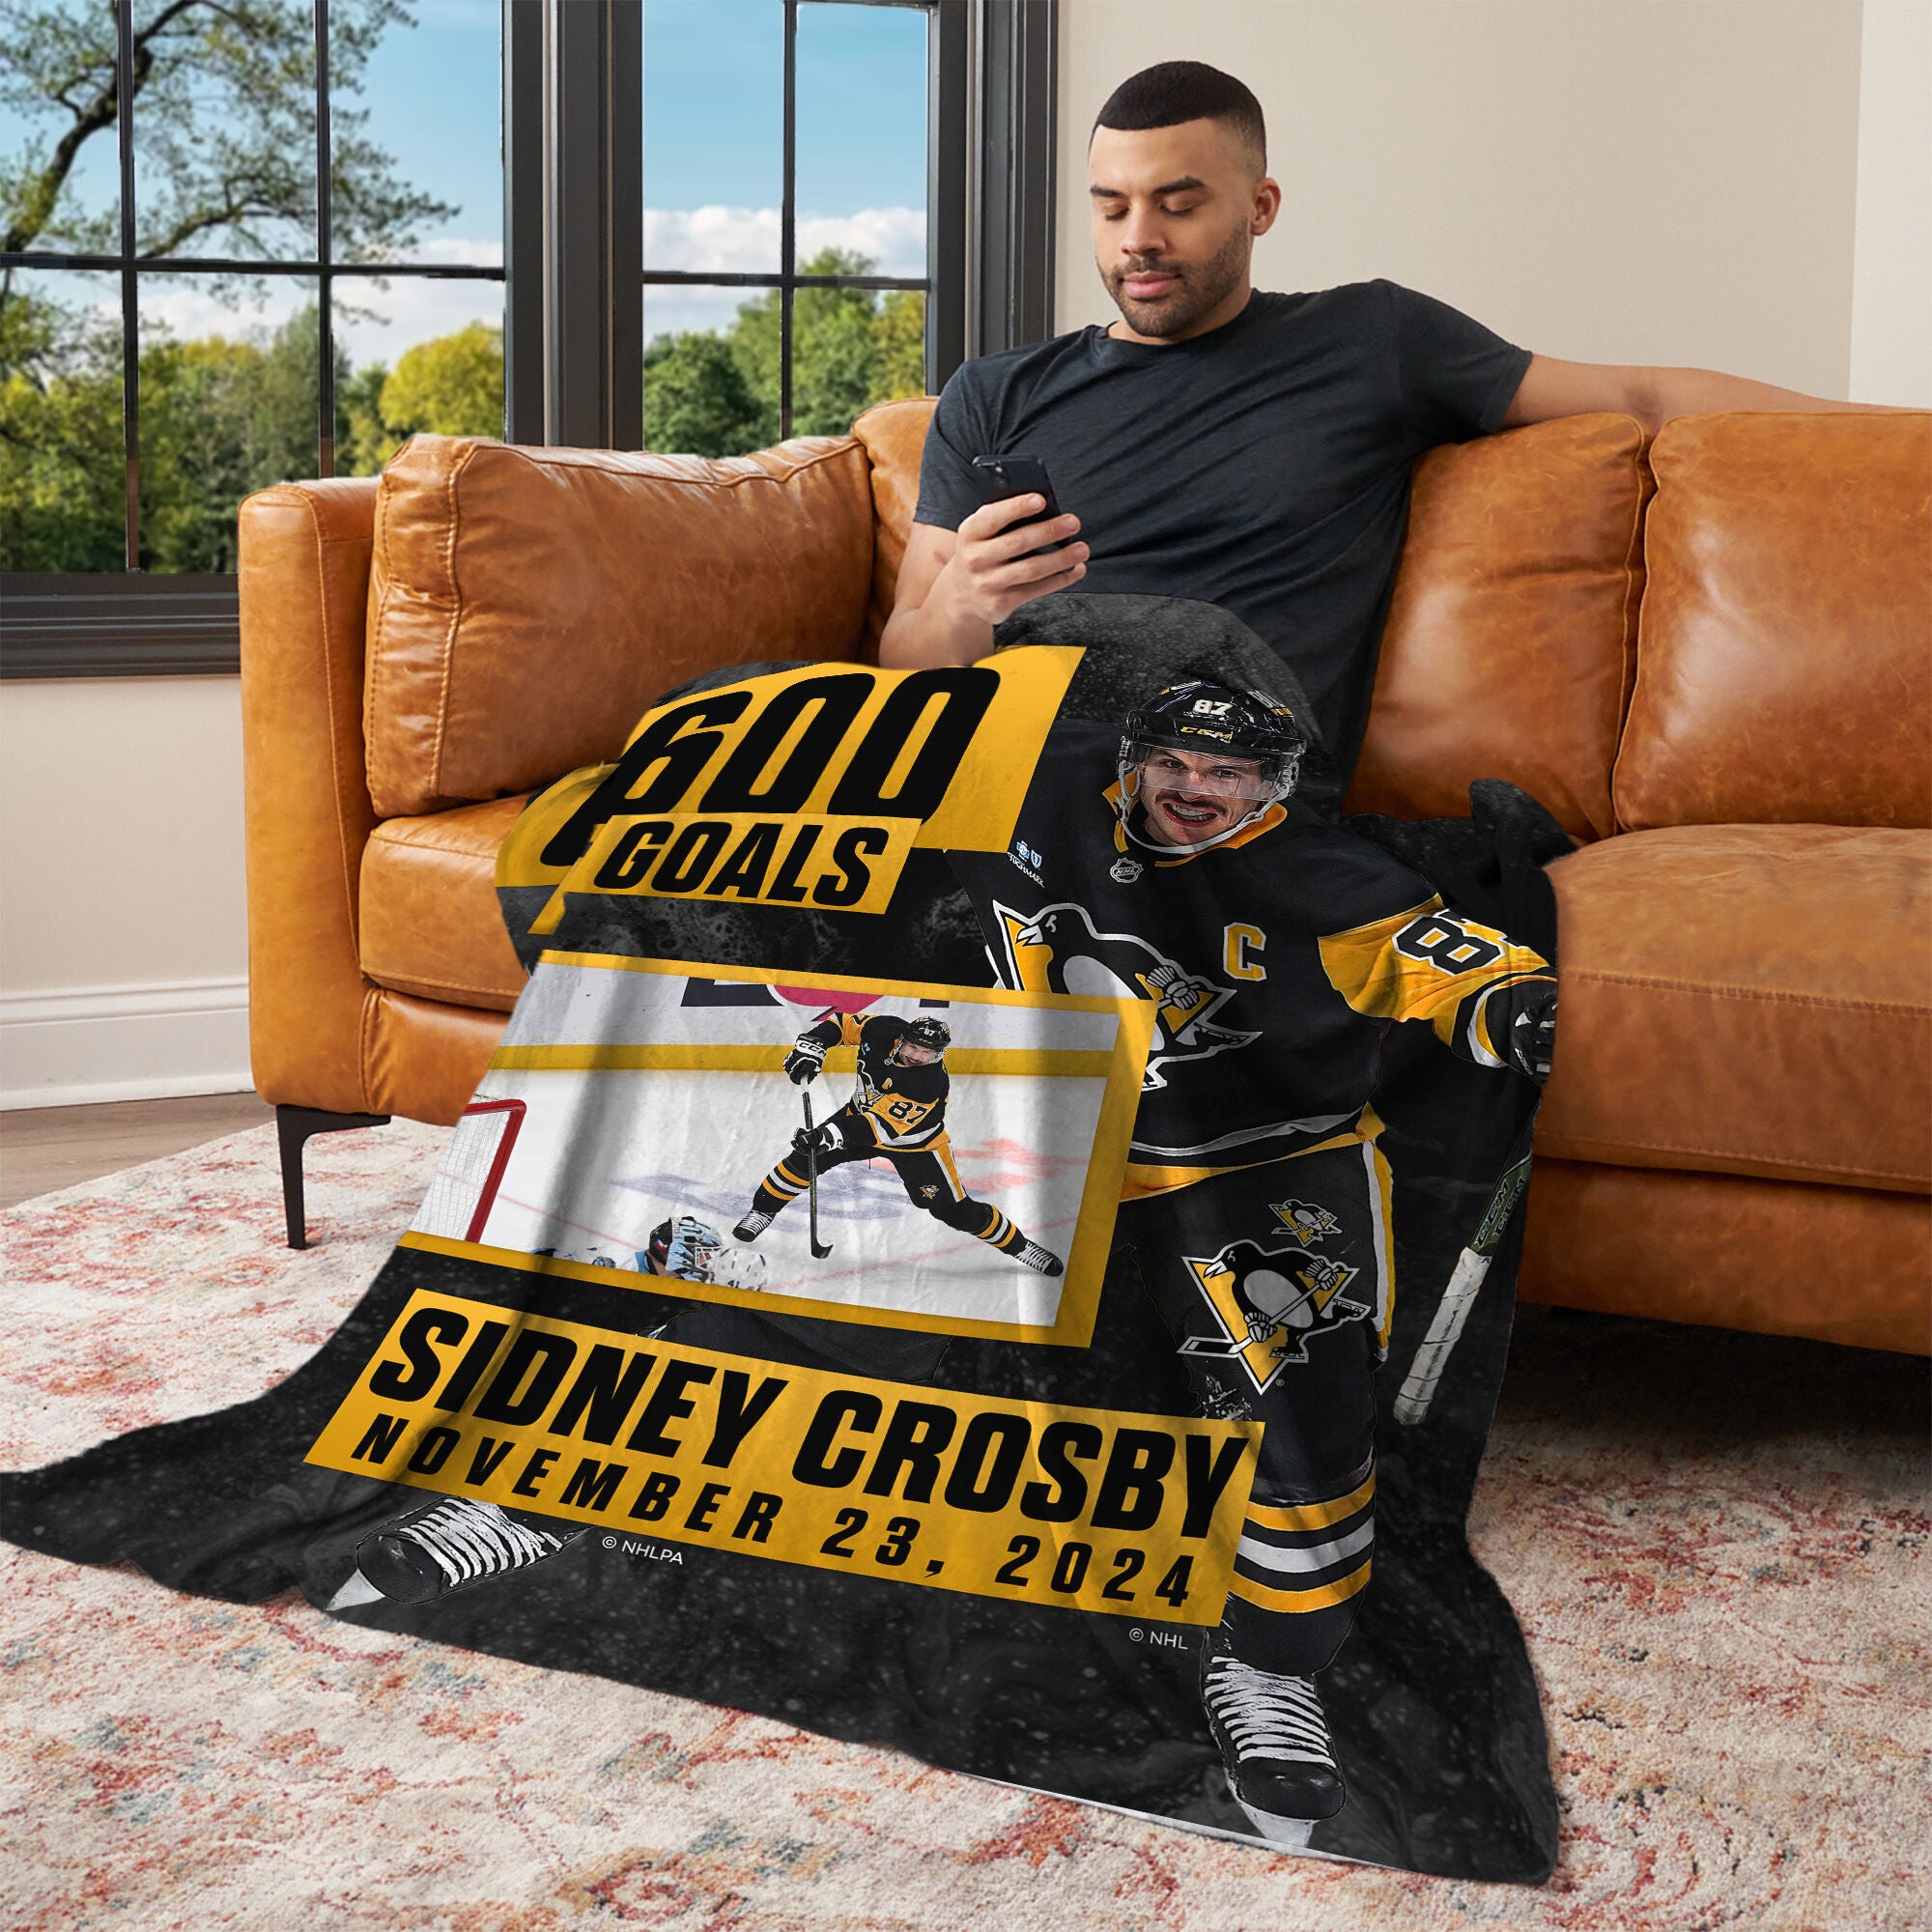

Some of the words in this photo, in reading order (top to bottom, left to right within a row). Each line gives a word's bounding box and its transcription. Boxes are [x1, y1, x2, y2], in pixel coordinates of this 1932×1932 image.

[1192, 698, 1234, 716] 87
[1179, 725, 1234, 744] CCM
[540, 667, 1001, 867] 600
[593, 820, 890, 907] GOALS
[1223, 922, 1267, 981] C
[887, 1100, 929, 1125] 87
[369, 1307, 789, 1469] SIDNEY
[792, 1389, 1249, 1540] CROSBY
[351, 1412, 783, 1544] NOVEMBER
[819, 1507, 945, 1578] 23,
[994, 1534, 1194, 1607] 2024
[621, 1540, 683, 1565] NHLPA
[1150, 1631, 1188, 1650] NHL
